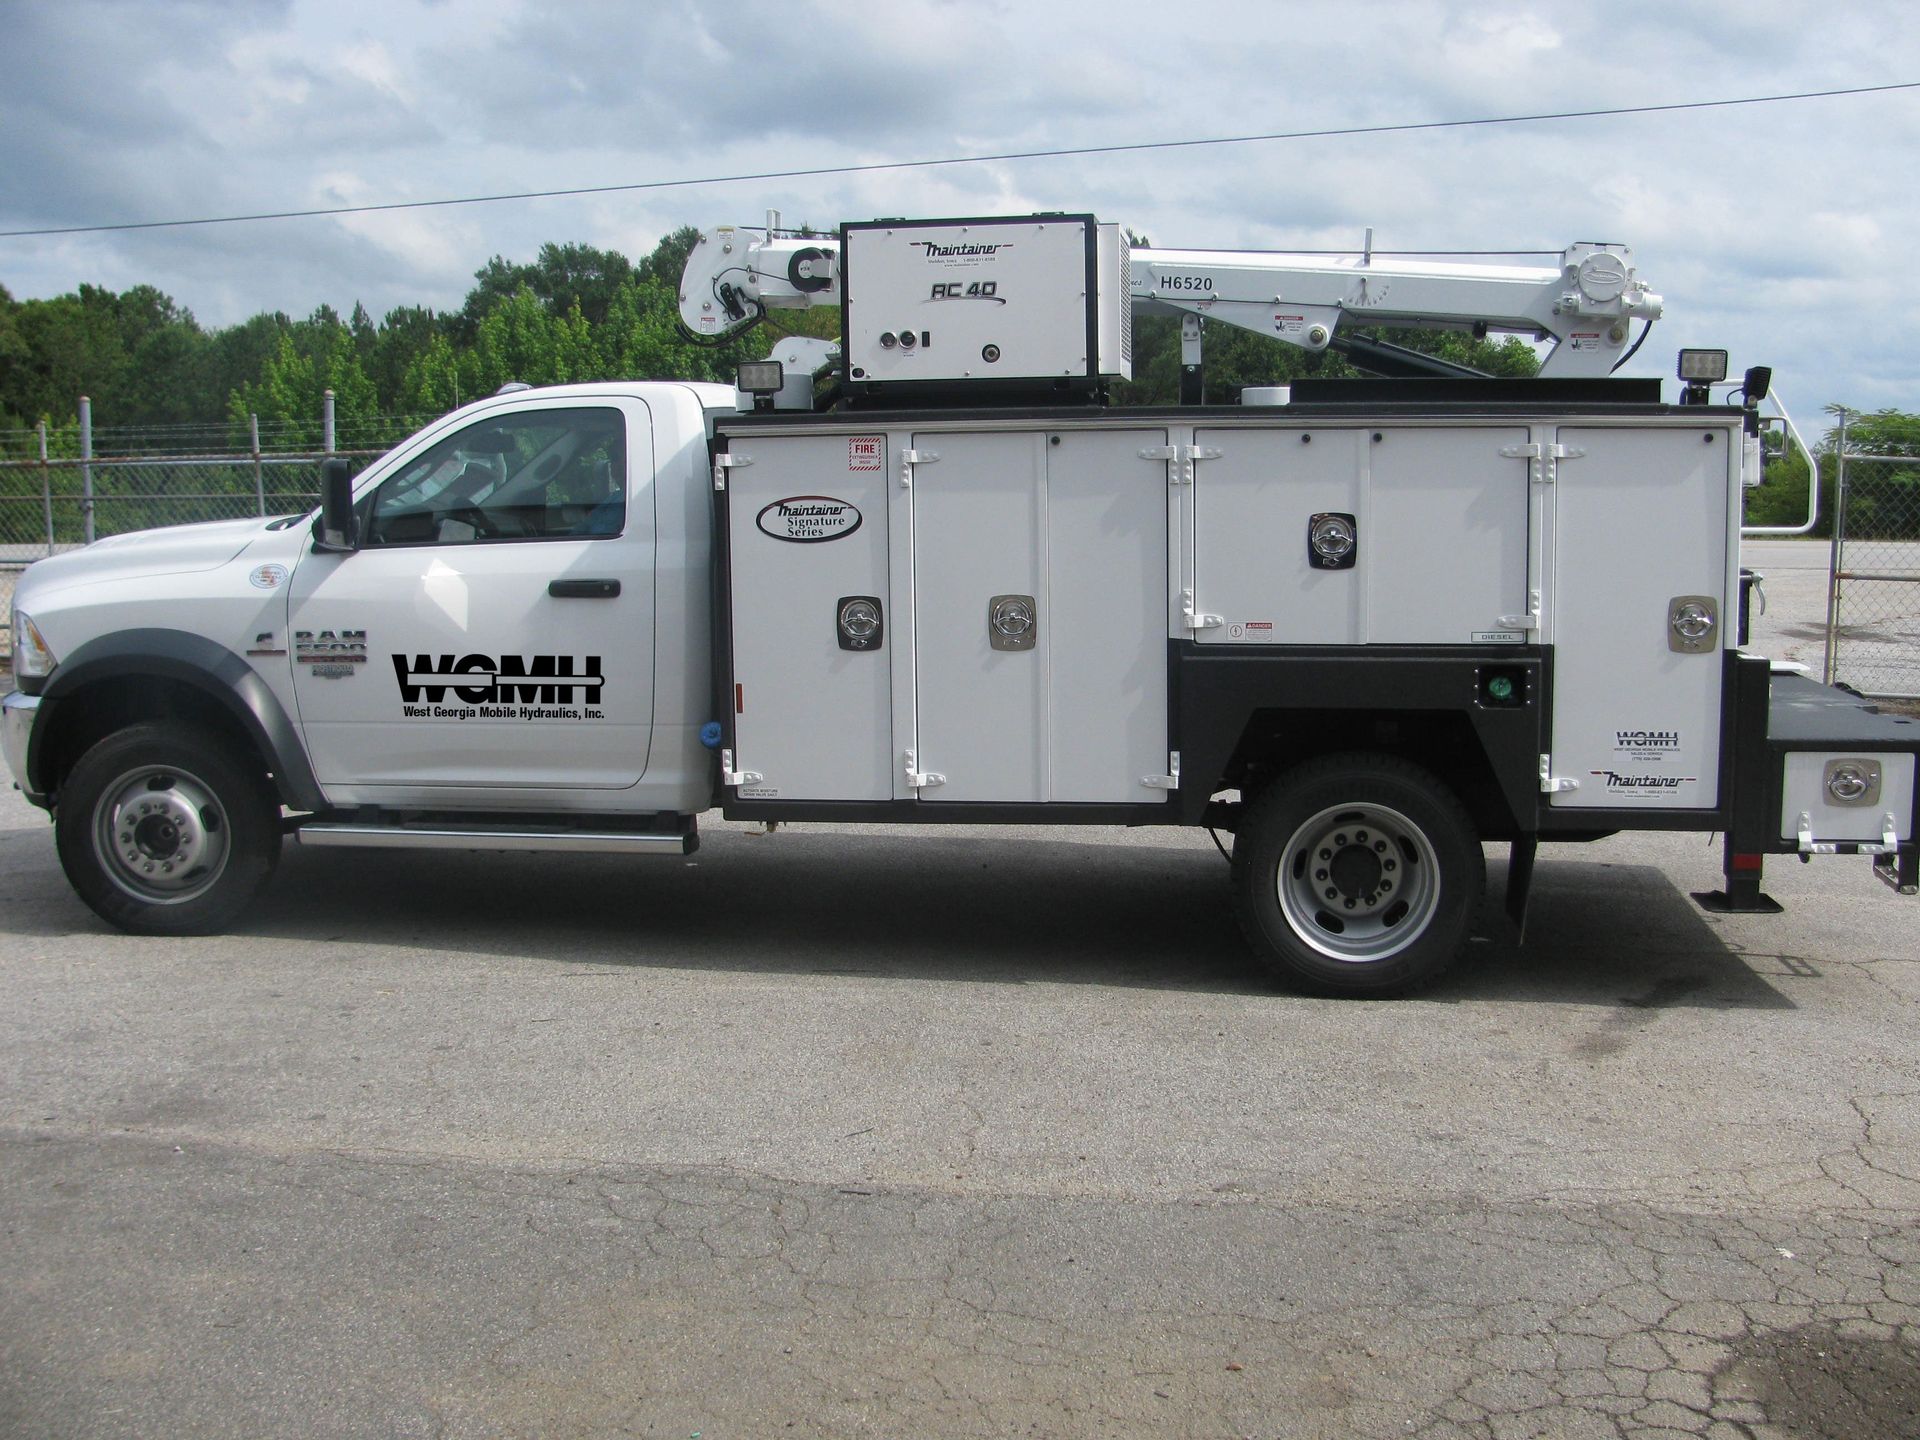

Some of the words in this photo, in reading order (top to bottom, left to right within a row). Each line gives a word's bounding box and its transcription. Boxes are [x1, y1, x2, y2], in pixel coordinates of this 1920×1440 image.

[921, 241, 1002, 257] Maintainer
[966, 281, 998, 297] 40
[1161, 276, 1213, 291] H6520
[855, 444, 875, 454] FIRE
[775, 502, 847, 517] Maintainer
[787, 516, 845, 530] Signature
[787, 527, 824, 537] Series
[391, 653, 605, 704] WGMH
[403, 706, 431, 717] West
[434, 706, 476, 720] Georgia
[479, 706, 517, 718] Mobile
[519, 706, 582, 720] Hydraulics,
[584, 707, 605, 719] Inc.
[1616, 731, 1678, 747] WGMH
[1602, 771, 1684, 787] Maintainer
